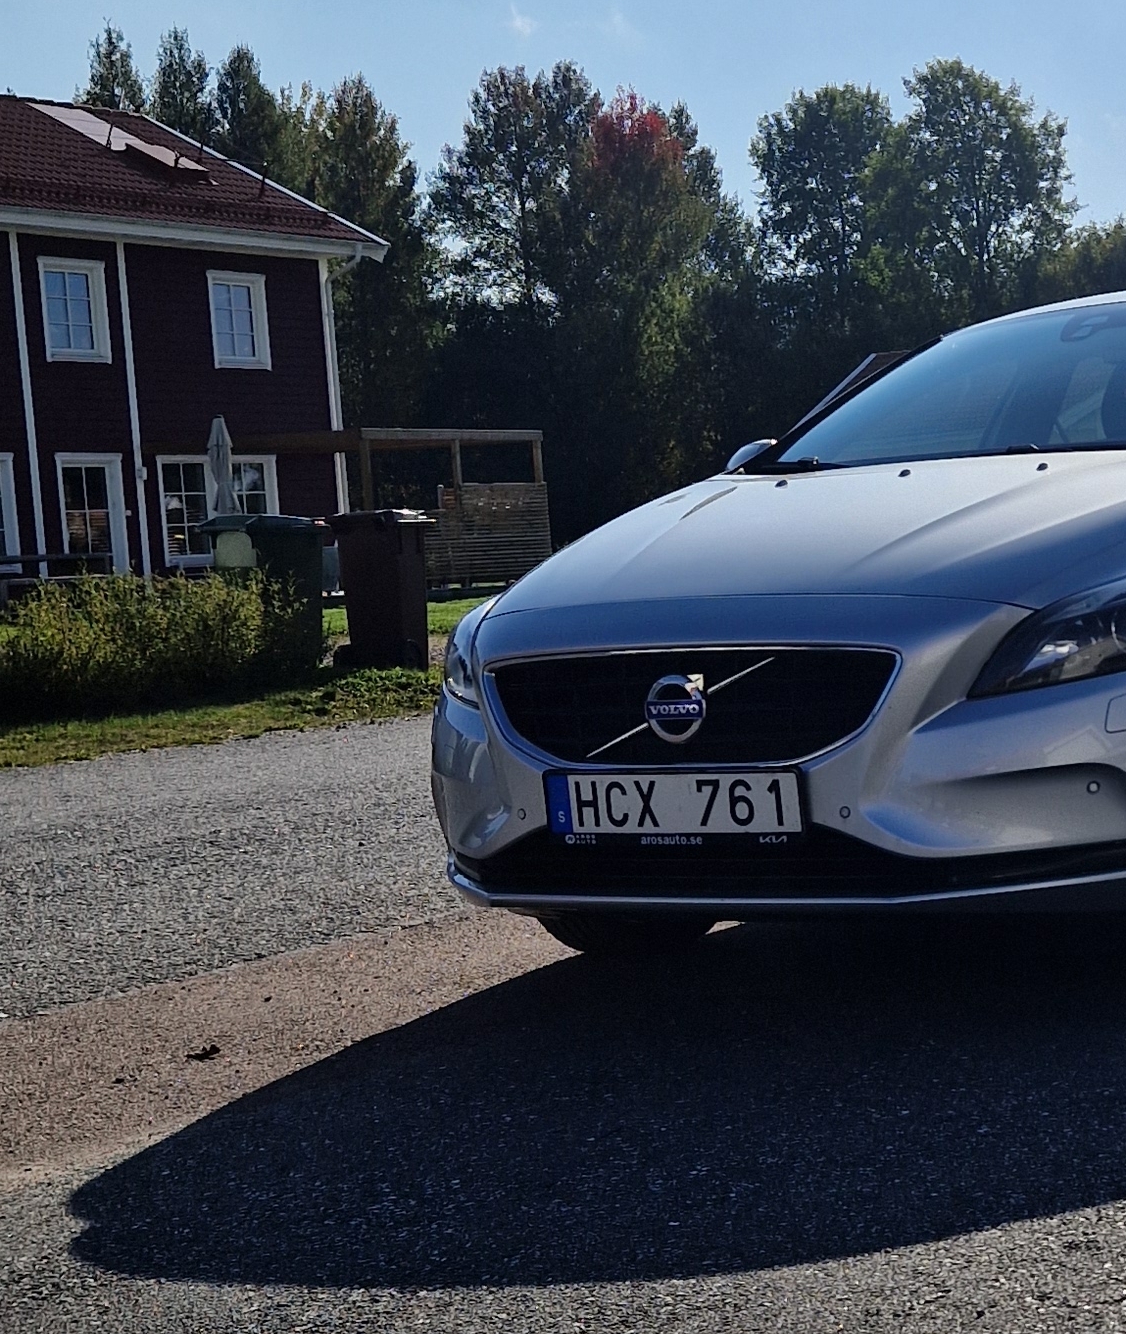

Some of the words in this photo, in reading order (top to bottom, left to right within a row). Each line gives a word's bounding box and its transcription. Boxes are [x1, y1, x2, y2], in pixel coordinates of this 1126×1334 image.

[648, 704, 699, 714] VOLVO
[574, 780, 660, 827] HCX
[695, 779, 784, 826] 761
[558, 811, 566, 823] S
[641, 835, 702, 845] arosauto.se
